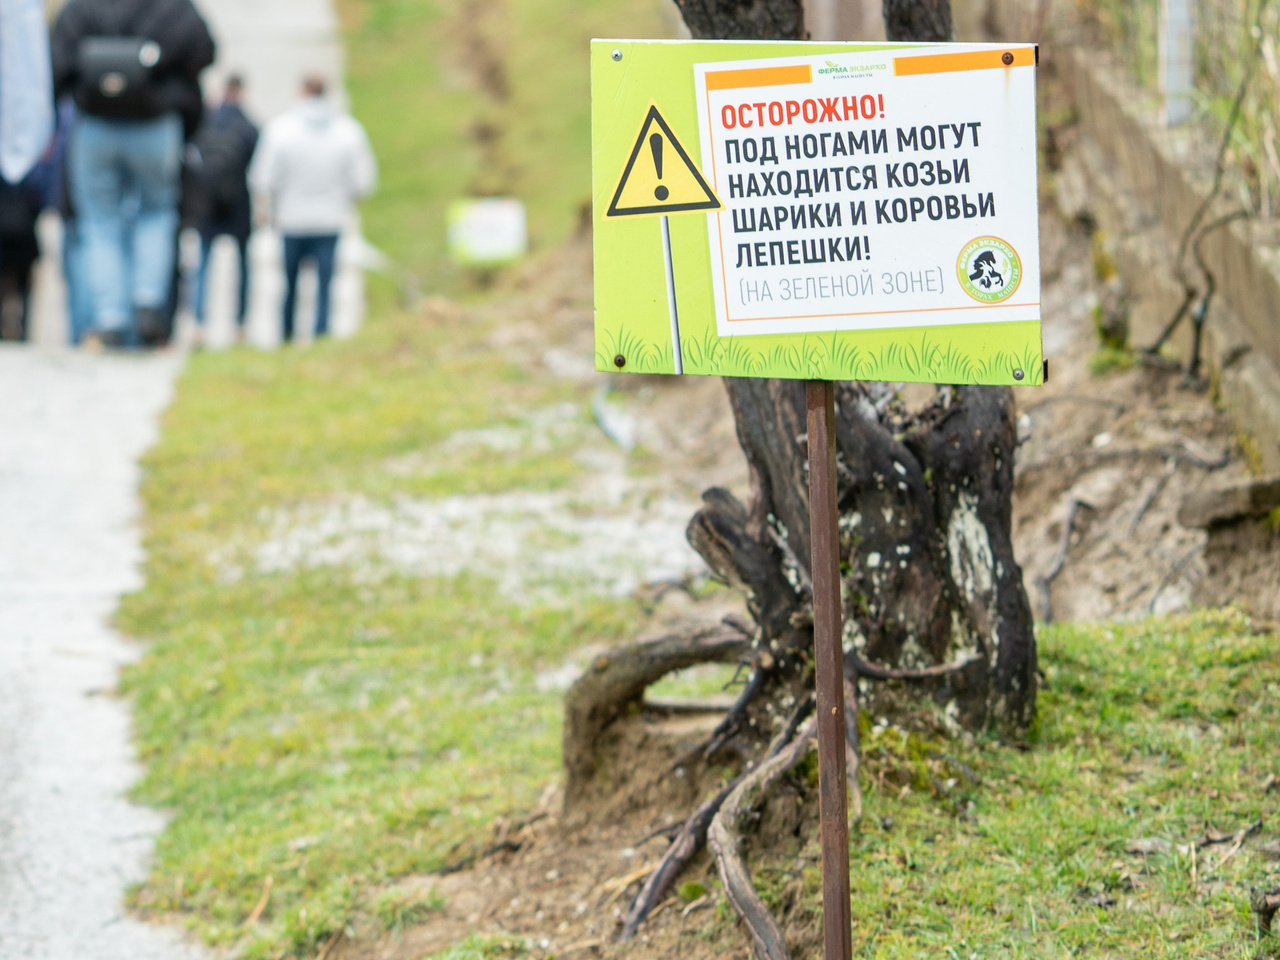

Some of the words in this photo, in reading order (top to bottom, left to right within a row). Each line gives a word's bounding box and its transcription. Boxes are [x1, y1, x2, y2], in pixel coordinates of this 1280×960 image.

[849, 64, 887, 72] ЭКЗАРХО
[721, 94, 885, 129] ОСТОРОЖНО!
[724, 138, 778, 166] ПОД
[785, 129, 888, 160] НОГАМИ
[896, 122, 981, 152] МОГУТ
[728, 164, 877, 198] НАХОДИТСЯ
[886, 158, 971, 187] КОЗЬИ
[731, 202, 842, 233] ШАРИКИ
[850, 201, 868, 226] И
[875, 192, 996, 224] КОРОВЬИ
[735, 235, 871, 269] ЛЕПЕШКИ!
[739, 277, 773, 306] (НА
[780, 269, 873, 300] ЗЕЛЕНОЙ
[882, 266, 945, 295] ЗОНЕ)
